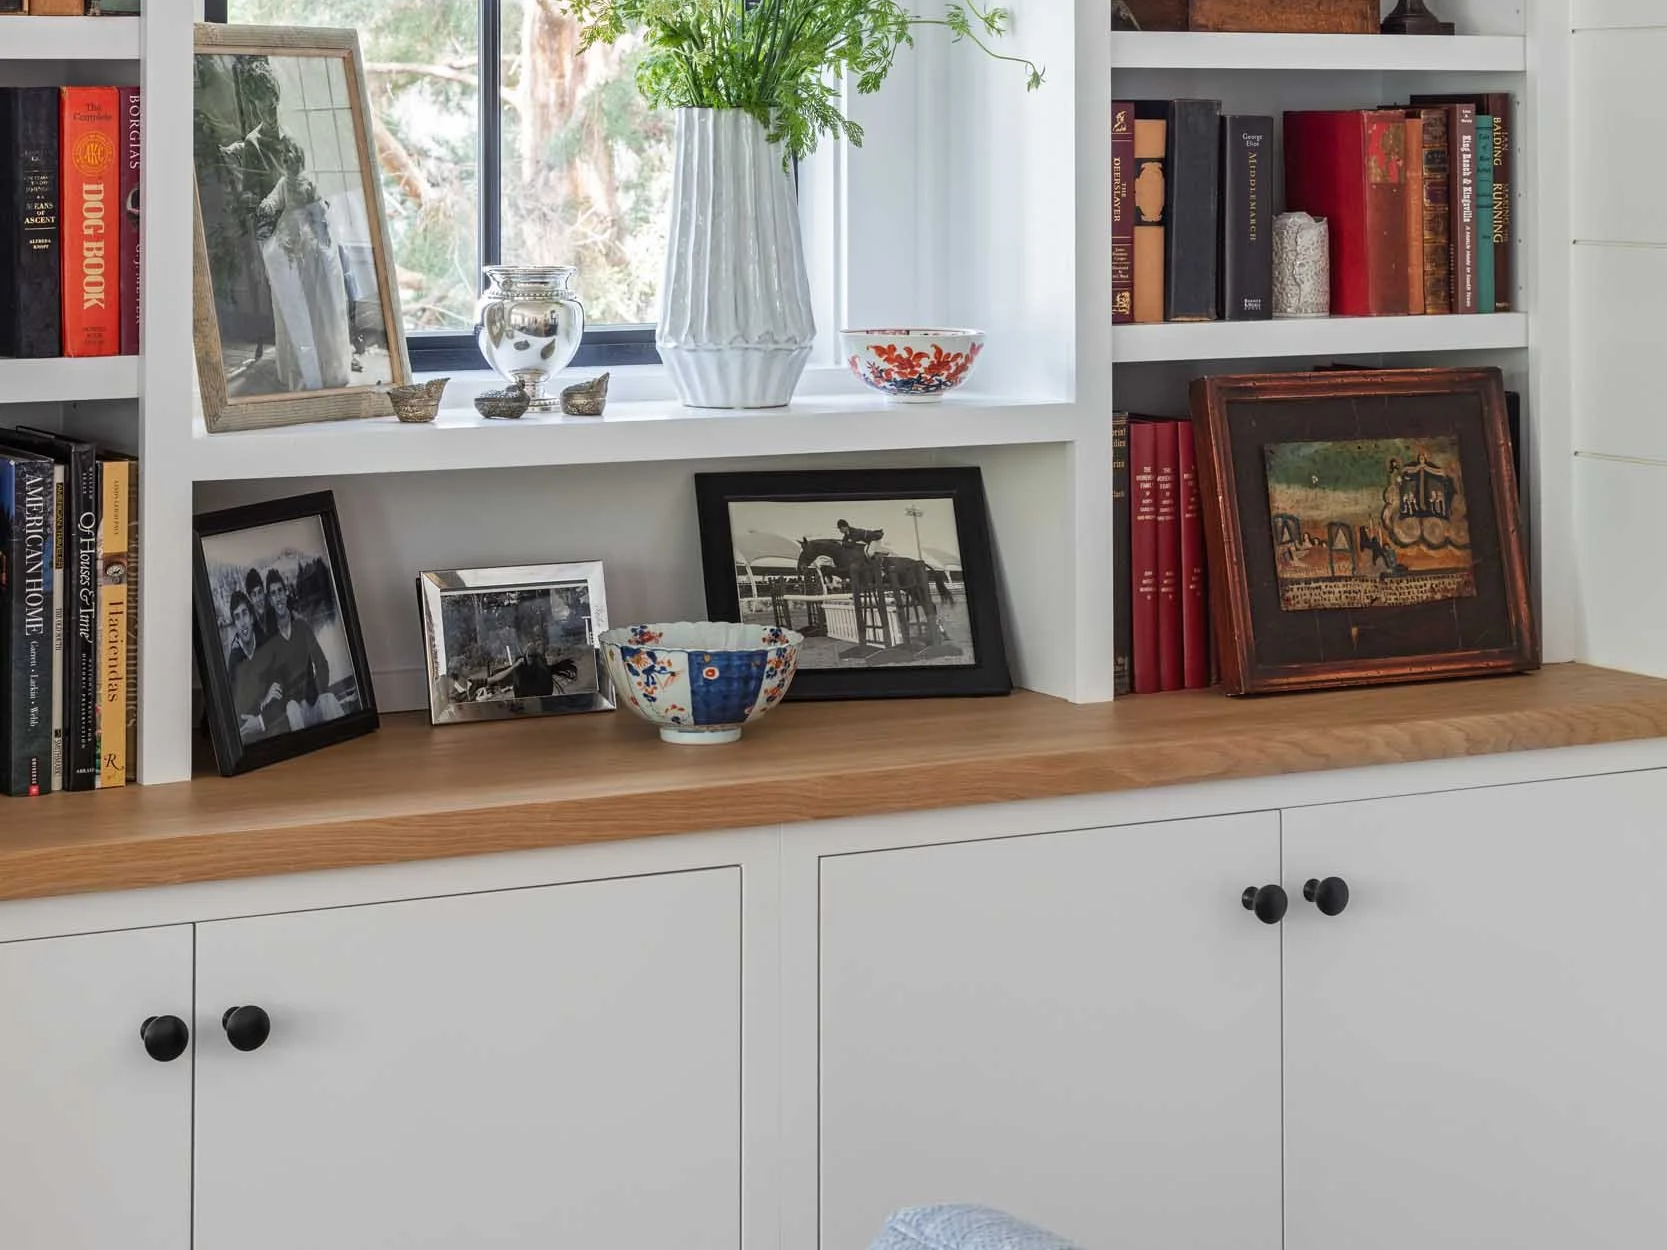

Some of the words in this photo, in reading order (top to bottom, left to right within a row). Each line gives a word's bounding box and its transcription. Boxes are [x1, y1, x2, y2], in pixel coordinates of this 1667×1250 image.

[129, 95, 141, 170] BORGIAS
[1460, 135, 1473, 152] King
[1493, 117, 1502, 166] BALDING
[1113, 157, 1121, 222] DEERSLAYER
[1462, 154, 1472, 176] Ranch
[24, 216, 56, 224] ASCENT
[83, 182, 105, 235] DOG
[1461, 186, 1472, 223] Kingsville
[1493, 183, 1503, 243] RUNNING
[83, 241, 105, 310] BOOK
[25, 474, 44, 574] AMERICAN
[78, 512, 96, 536] Of
[79, 537, 95, 586] Houses
[25, 578, 43, 636] HOME
[79, 588, 95, 606] &
[30, 640, 39, 667] Garrett
[107, 601, 124, 703] Haciendas
[30, 674, 39, 699] Larkin
[30, 707, 39, 727] Webb
